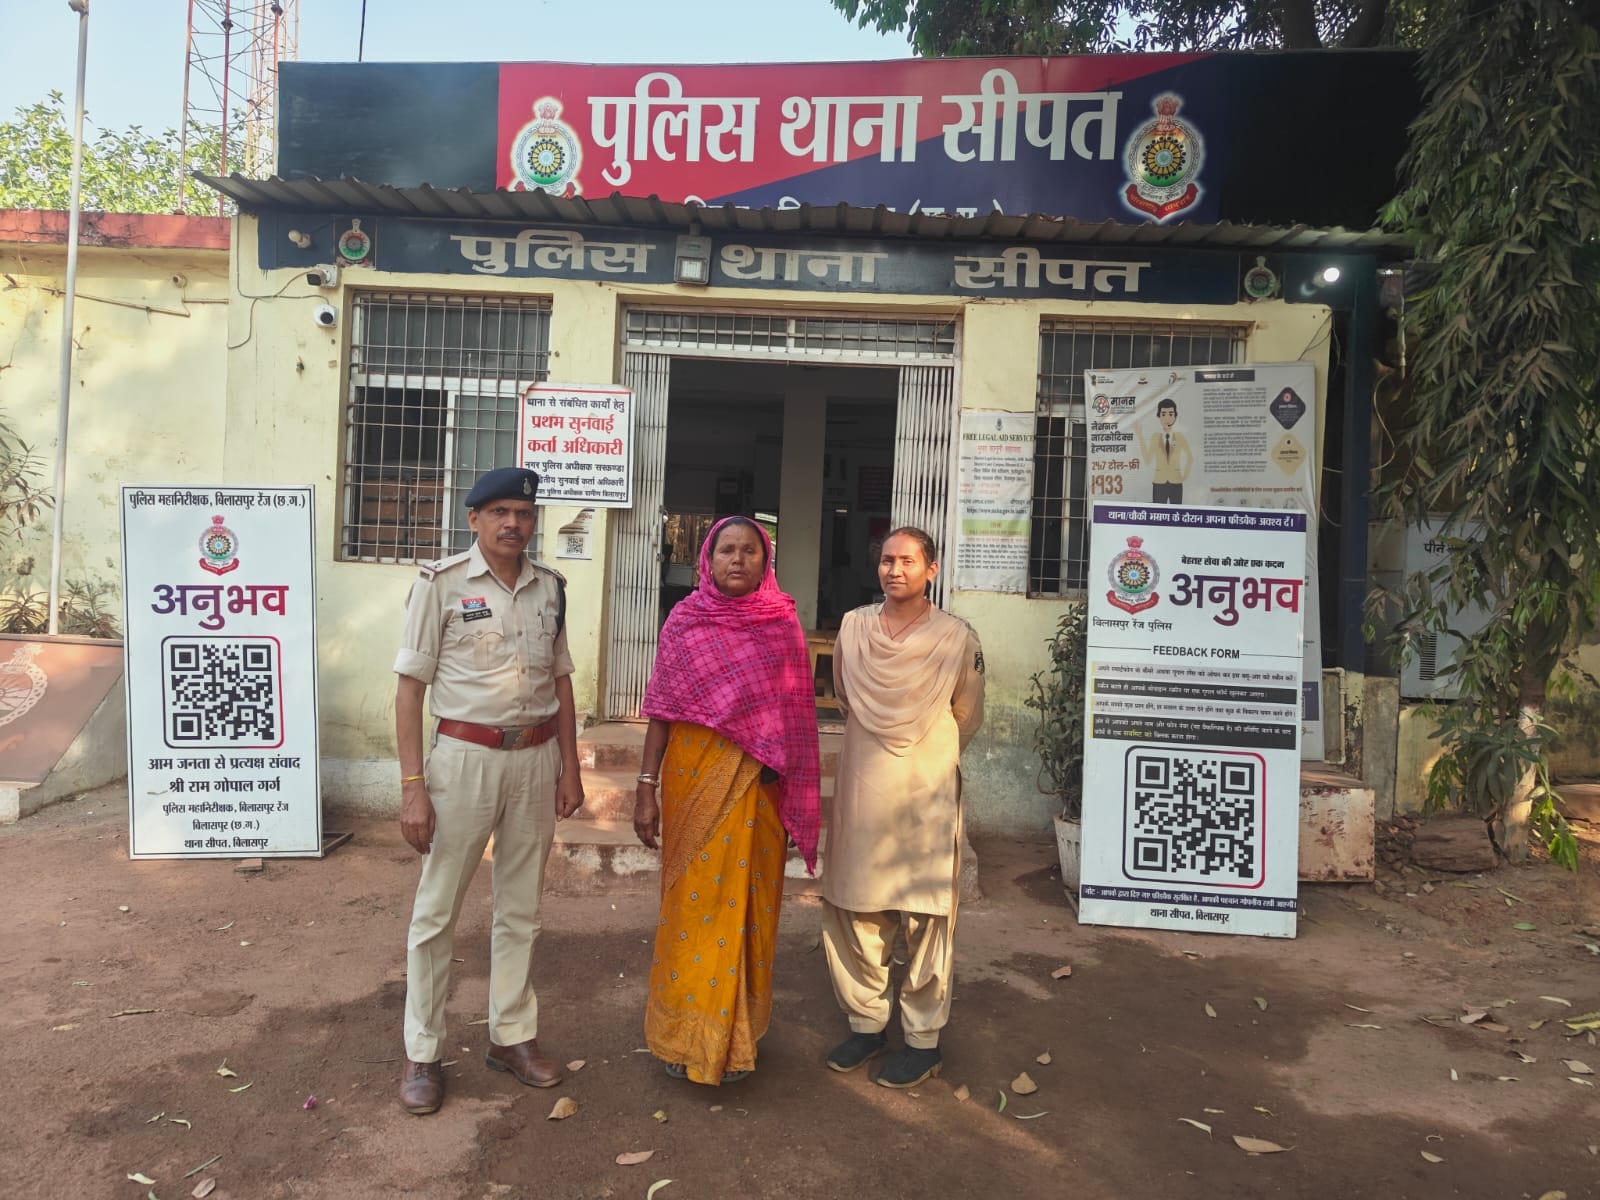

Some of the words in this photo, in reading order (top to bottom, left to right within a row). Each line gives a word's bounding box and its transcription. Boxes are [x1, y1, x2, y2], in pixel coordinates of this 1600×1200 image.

[588, 72, 760, 185] पुलिस
[781, 94, 922, 163] थाना
[943, 68, 1123, 162] सीपत
[450, 230, 656, 274] पुलिस
[721, 244, 888, 283] थाना
[953, 246, 1151, 293] सीपत
[548, 397, 556, 407] से
[613, 399, 625, 413] हेतु
[1110, 397, 1136, 406] मानस
[532, 415, 564, 429] प्रथम
[569, 413, 615, 434] सुनवाई
[963, 433, 977, 441] FREE
[978, 433, 998, 441] LEGAL
[999, 434, 1008, 442] AID
[1091, 432, 1133, 442] नारकोटिक्स
[528, 436, 557, 453] कर्ता
[562, 436, 623, 455] अधिकारी
[1091, 443, 1127, 454] हेल्पलाइन
[525, 461, 540, 470] नगर
[542, 460, 562, 472] पुलिस
[565, 460, 592, 471] अधीक्षक
[558, 476, 580, 487] सुनवाई
[581, 476, 594, 485] कर्ता
[597, 477, 624, 487] अधिकारी
[1091, 475, 1123, 495] 1933
[129, 490, 154, 508] पुलिस
[158, 490, 212, 507] महानिरीक्षक,
[215, 491, 254, 509] बिलासपुर
[257, 491, 270, 506] रेंज
[1108, 509, 1146, 521] थाना/चौकी
[1172, 512, 1180, 523] के
[1182, 512, 1202, 524] दौरान
[1205, 516, 1226, 525] अपना
[1228, 514, 1257, 526] फीडबैक
[1259, 517, 1282, 527] अवश्य
[1181, 555, 1202, 566] बेहतर
[1204, 555, 1219, 567] सेवा
[1221, 556, 1231, 568] की
[1233, 557, 1248, 568] ओर
[1250, 559, 1263, 568] एक
[1265, 560, 1284, 570] कदम
[151, 584, 289, 630] अनुभव
[1169, 573, 1303, 627] अनुभव
[1132, 618, 1144, 629] रेंज
[1148, 618, 1172, 632] पुलिस
[1153, 645, 1208, 658] FEEDBACK
[1211, 647, 1240, 659] FORM
[148, 758, 172, 770] आम
[177, 757, 210, 769] जनता
[215, 754, 225, 769] से
[230, 757, 264, 769] प्रत्यक्ष
[269, 753, 300, 768] संवाद
[169, 777, 184, 792] श्री
[188, 780, 209, 792] राम
[214, 777, 253, 792] गोपाल
[257, 777, 280, 791] गर्ग
[162, 802, 185, 816] पुलिस
[188, 801, 236, 813] महानिरीक्षक,
[239, 801, 274, 814] बिलासपुर
[277, 800, 288, 812] रेंज
[192, 818, 228, 832] बिलासपुर
[184, 839, 202, 848] थाना
[233, 836, 268, 849] बिलासपुर
[1150, 909, 1167, 918] थाना
[1196, 910, 1229, 925] बिलासपुर
